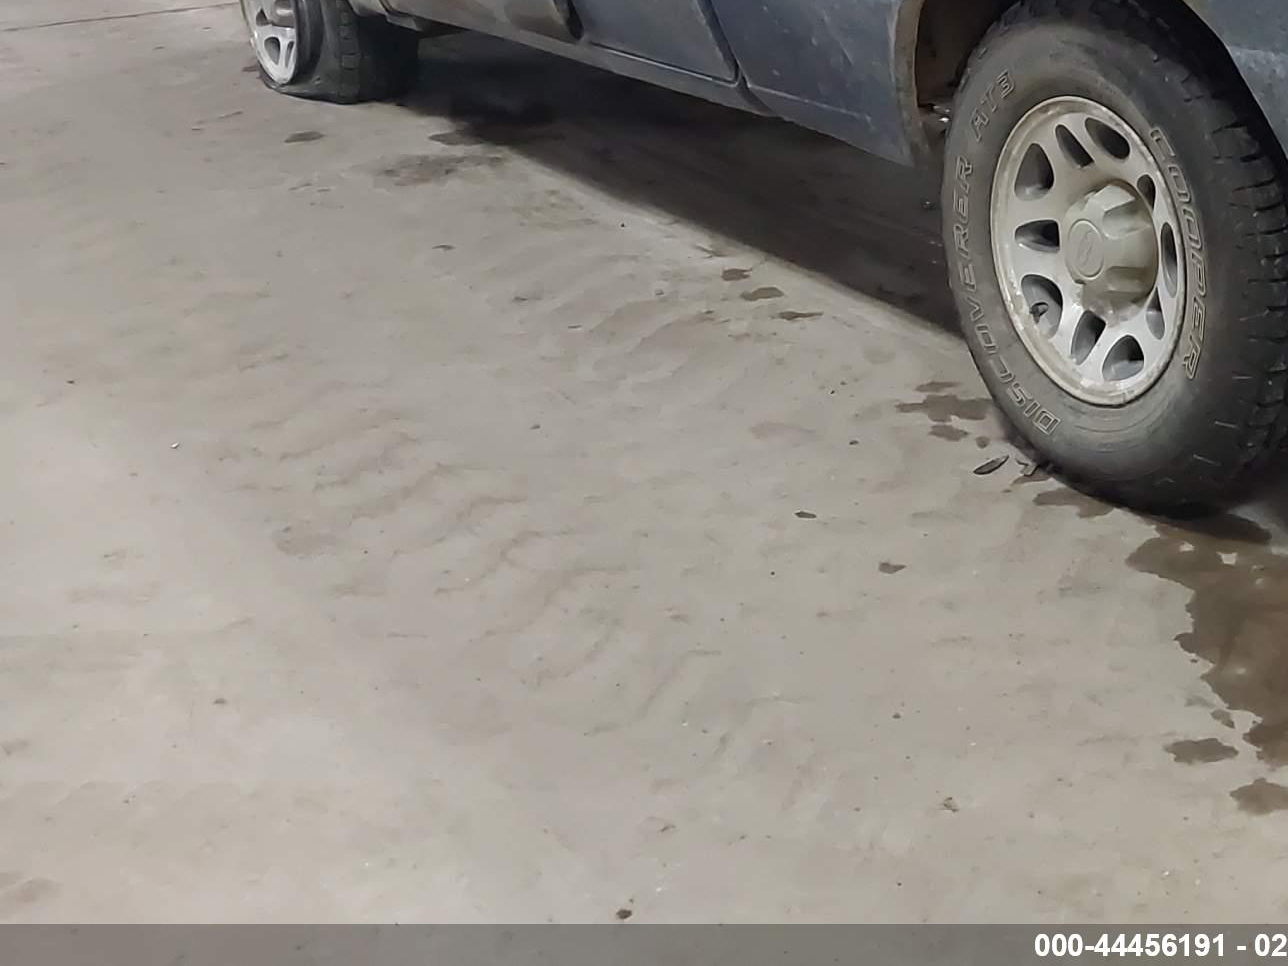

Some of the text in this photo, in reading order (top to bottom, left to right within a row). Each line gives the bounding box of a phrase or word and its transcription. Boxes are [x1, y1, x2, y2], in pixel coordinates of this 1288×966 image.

[951, 68, 1061, 435] DISCOVERER AT3
[1150, 126, 1208, 380] COOPER
